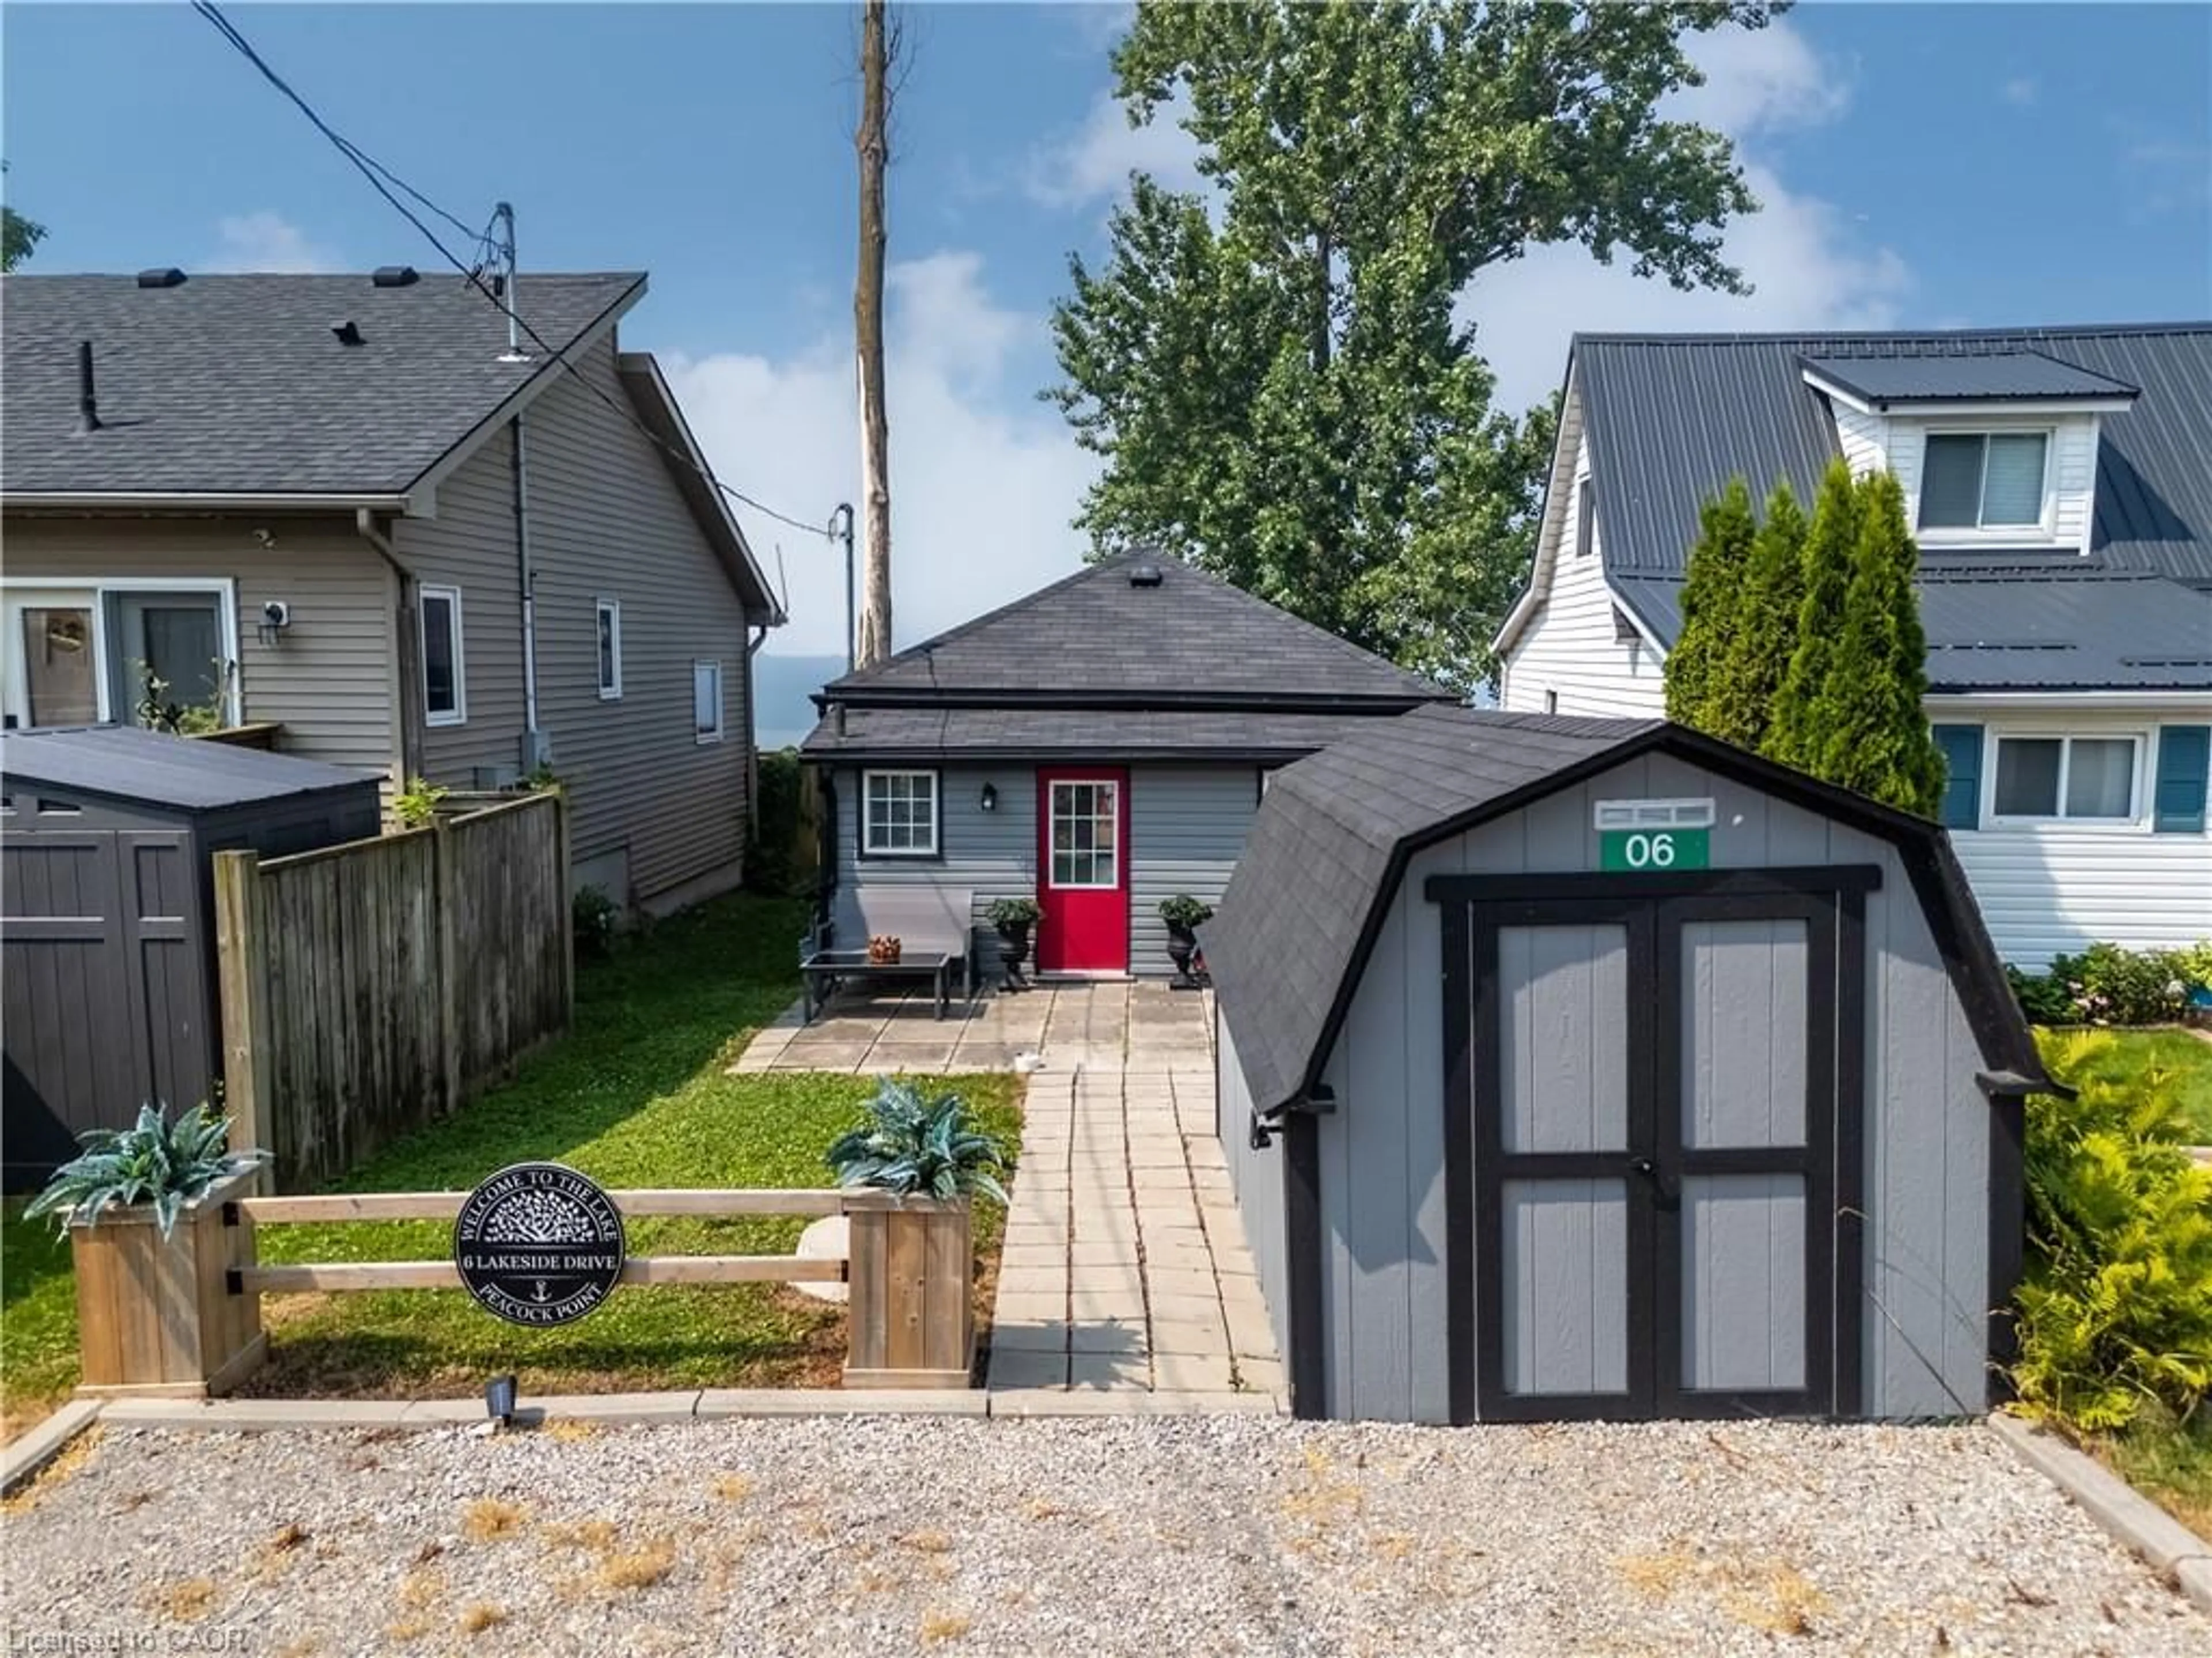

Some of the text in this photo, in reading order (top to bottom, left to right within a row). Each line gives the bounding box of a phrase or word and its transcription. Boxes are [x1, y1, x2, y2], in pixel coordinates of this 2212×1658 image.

[1626, 834, 1675, 867] 06
[461, 1171, 617, 1242] WELCOME TO THE LAKE
[464, 1255, 616, 1269] 6 LAKESIDE DRIVE
[479, 1284, 602, 1321] PEACOCK POINT
